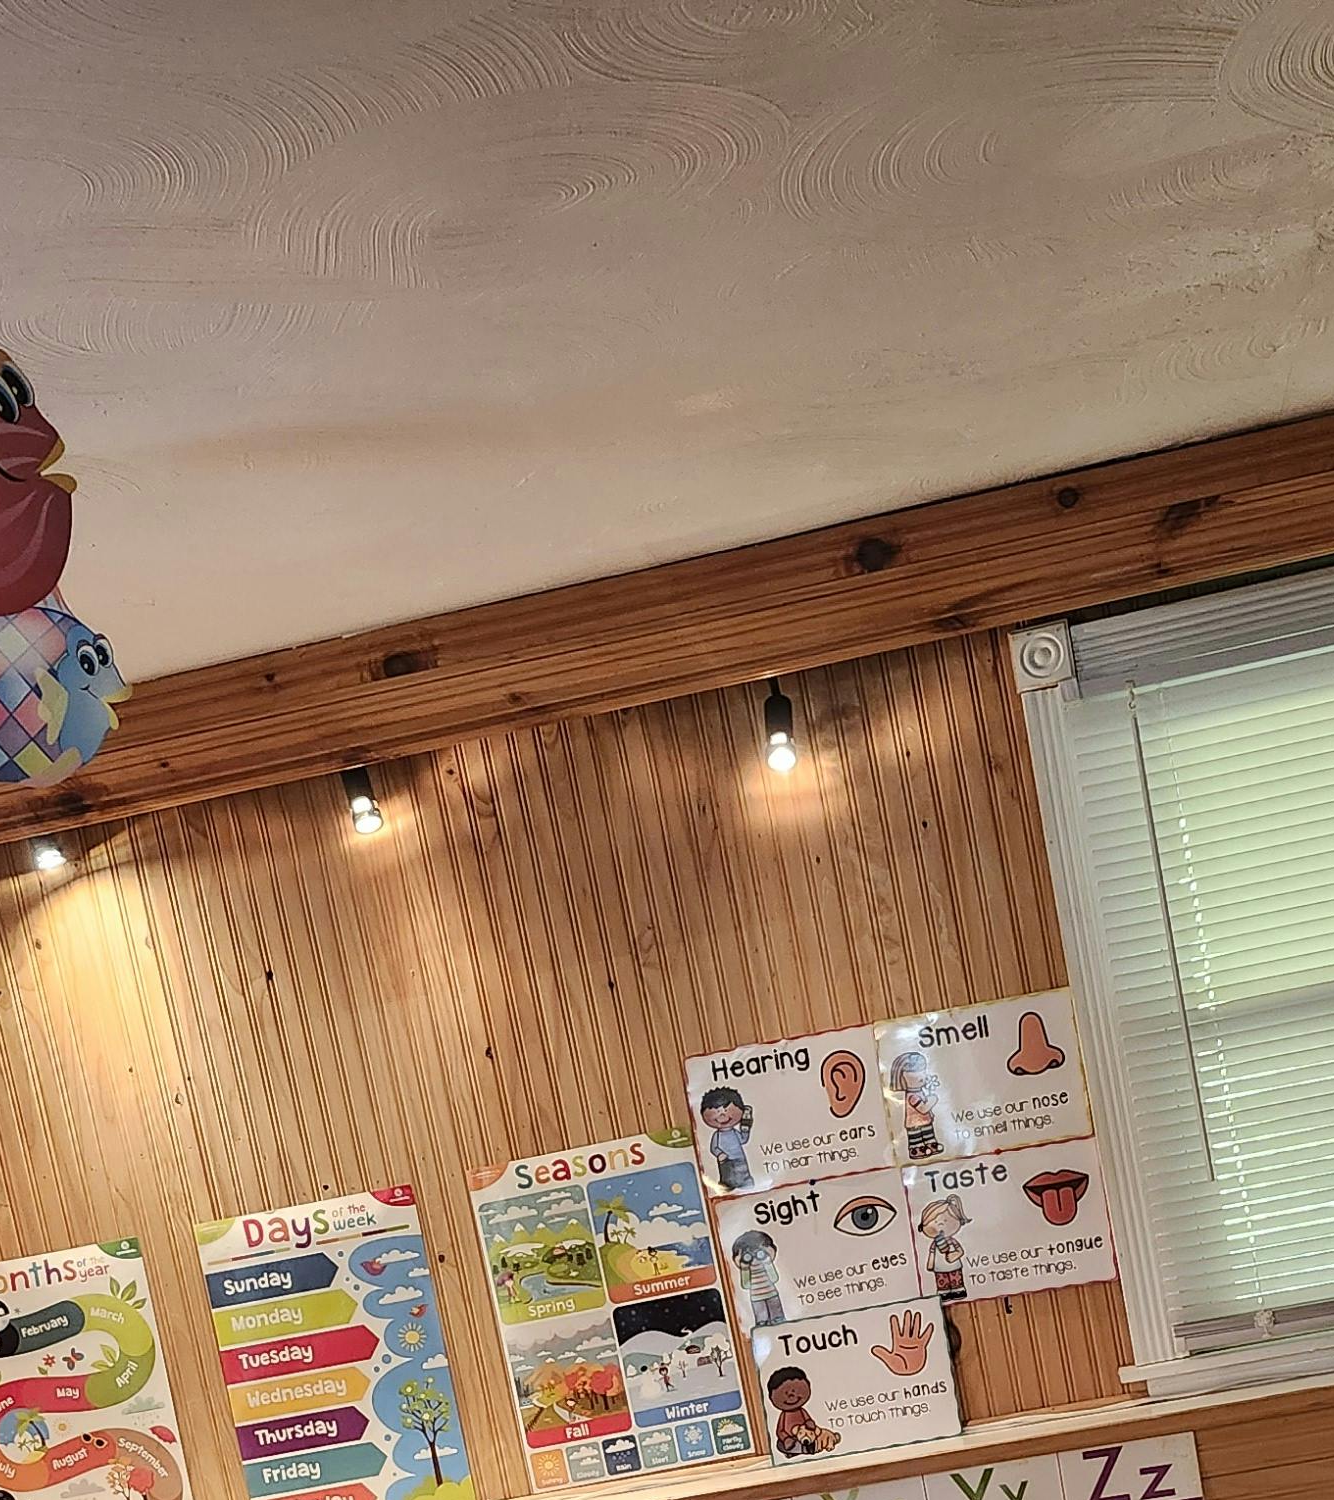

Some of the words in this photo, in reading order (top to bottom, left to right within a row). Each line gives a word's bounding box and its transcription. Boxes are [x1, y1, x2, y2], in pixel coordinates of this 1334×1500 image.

[918, 1014, 990, 1048] Smell
[710, 1047, 811, 1082] Hearing
[951, 1109, 975, 1124] We
[977, 1103, 1002, 1119] use
[1004, 1099, 1029, 1115] our
[1031, 1090, 1069, 1110] nose
[973, 1121, 1008, 1138] smell
[1010, 1113, 1054, 1132] things.
[759, 1142, 784, 1156] We
[785, 1137, 811, 1151] use
[812, 1131, 835, 1147] our
[838, 1124, 876, 1142] ears
[514, 1141, 646, 1190] Seasons
[763, 1160, 780, 1174] to
[782, 1153, 814, 1169] hear
[816, 1145, 860, 1164] things.
[924, 1161, 1008, 1194] Taste
[331, 1206, 345, 1218] of
[347, 1203, 366, 1215] the
[333, 1211, 377, 1232] week
[753, 1190, 820, 1225] Sight
[242, 1209, 331, 1249] Days
[76, 1257, 88, 1269] of
[966, 1253, 990, 1268] We
[992, 1249, 1018, 1264] use
[1020, 1246, 1044, 1260] our
[1047, 1235, 1103, 1256] tongue
[78, 1262, 111, 1283] year
[223, 1270, 293, 1296] Sunday
[793, 1274, 817, 1290] We
[818, 1268, 843, 1284] use
[845, 1263, 868, 1278] our
[870, 1251, 907, 1272] eyes
[969, 1273, 987, 1287] to
[988, 1265, 1030, 1282] taste
[1031, 1258, 1077, 1276] things.
[633, 1273, 691, 1298] Summer
[797, 1293, 815, 1306] to
[816, 1284, 842, 1299] see
[844, 1274, 887, 1296] things.
[90, 1306, 125, 1325] March
[230, 1305, 303, 1333] Monday
[527, 1296, 576, 1319] Spring
[20, 1314, 69, 1338] February
[778, 1323, 858, 1356] Touch
[238, 1343, 313, 1370] Tuesday
[115, 1359, 139, 1388] April
[55, 1385, 81, 1400] May
[246, 1378, 348, 1408] Wednesday
[824, 1399, 848, 1412] We
[850, 1394, 875, 1407] use
[877, 1390, 900, 1403] our
[902, 1380, 948, 1400] hands
[664, 1400, 710, 1421] Winter
[827, 1416, 844, 1428] to
[847, 1408, 886, 1425] touch
[888, 1401, 931, 1418] things.
[254, 1419, 338, 1446] Thursday
[565, 1424, 590, 1440] Fall
[51, 1446, 89, 1471] August
[117, 1436, 169, 1479] September
[261, 1461, 321, 1484] Friday
